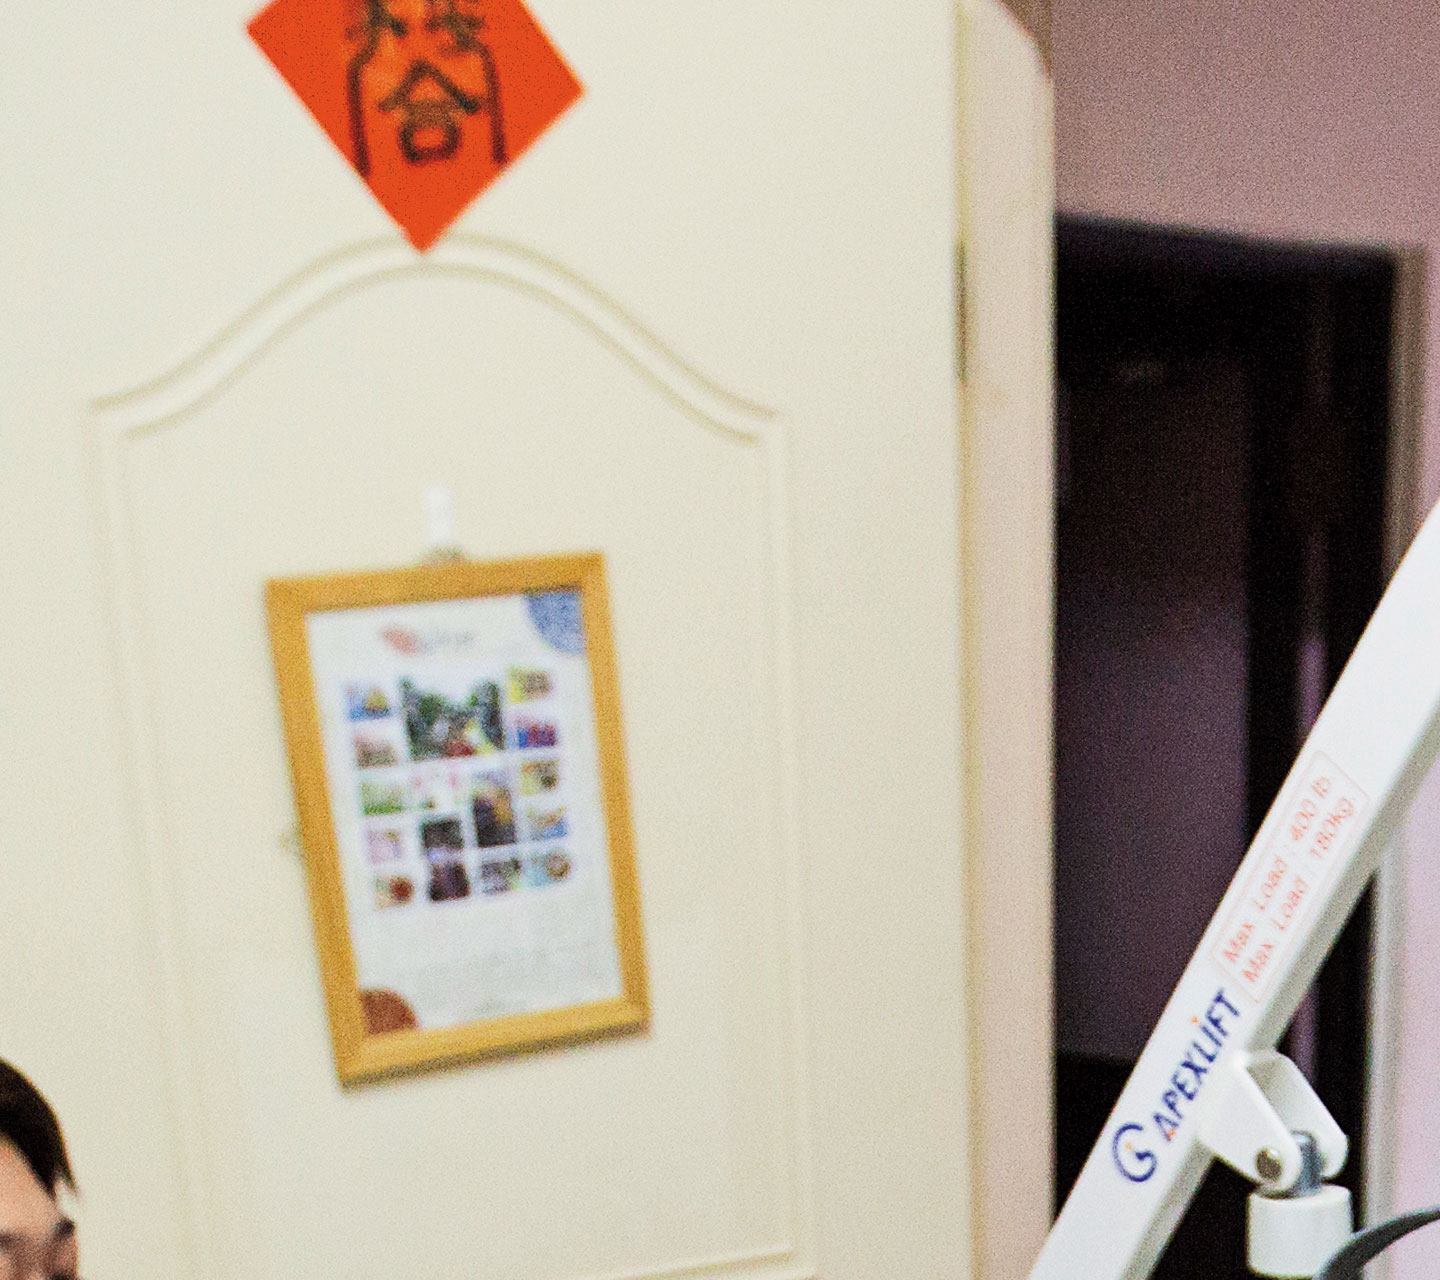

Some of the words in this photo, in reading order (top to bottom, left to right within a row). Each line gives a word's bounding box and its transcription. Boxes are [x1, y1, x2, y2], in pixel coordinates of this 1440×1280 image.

[1224, 923, 1254, 963] Max
[1291, 799, 1317, 840] 400
[1243, 943, 1274, 982] Max
